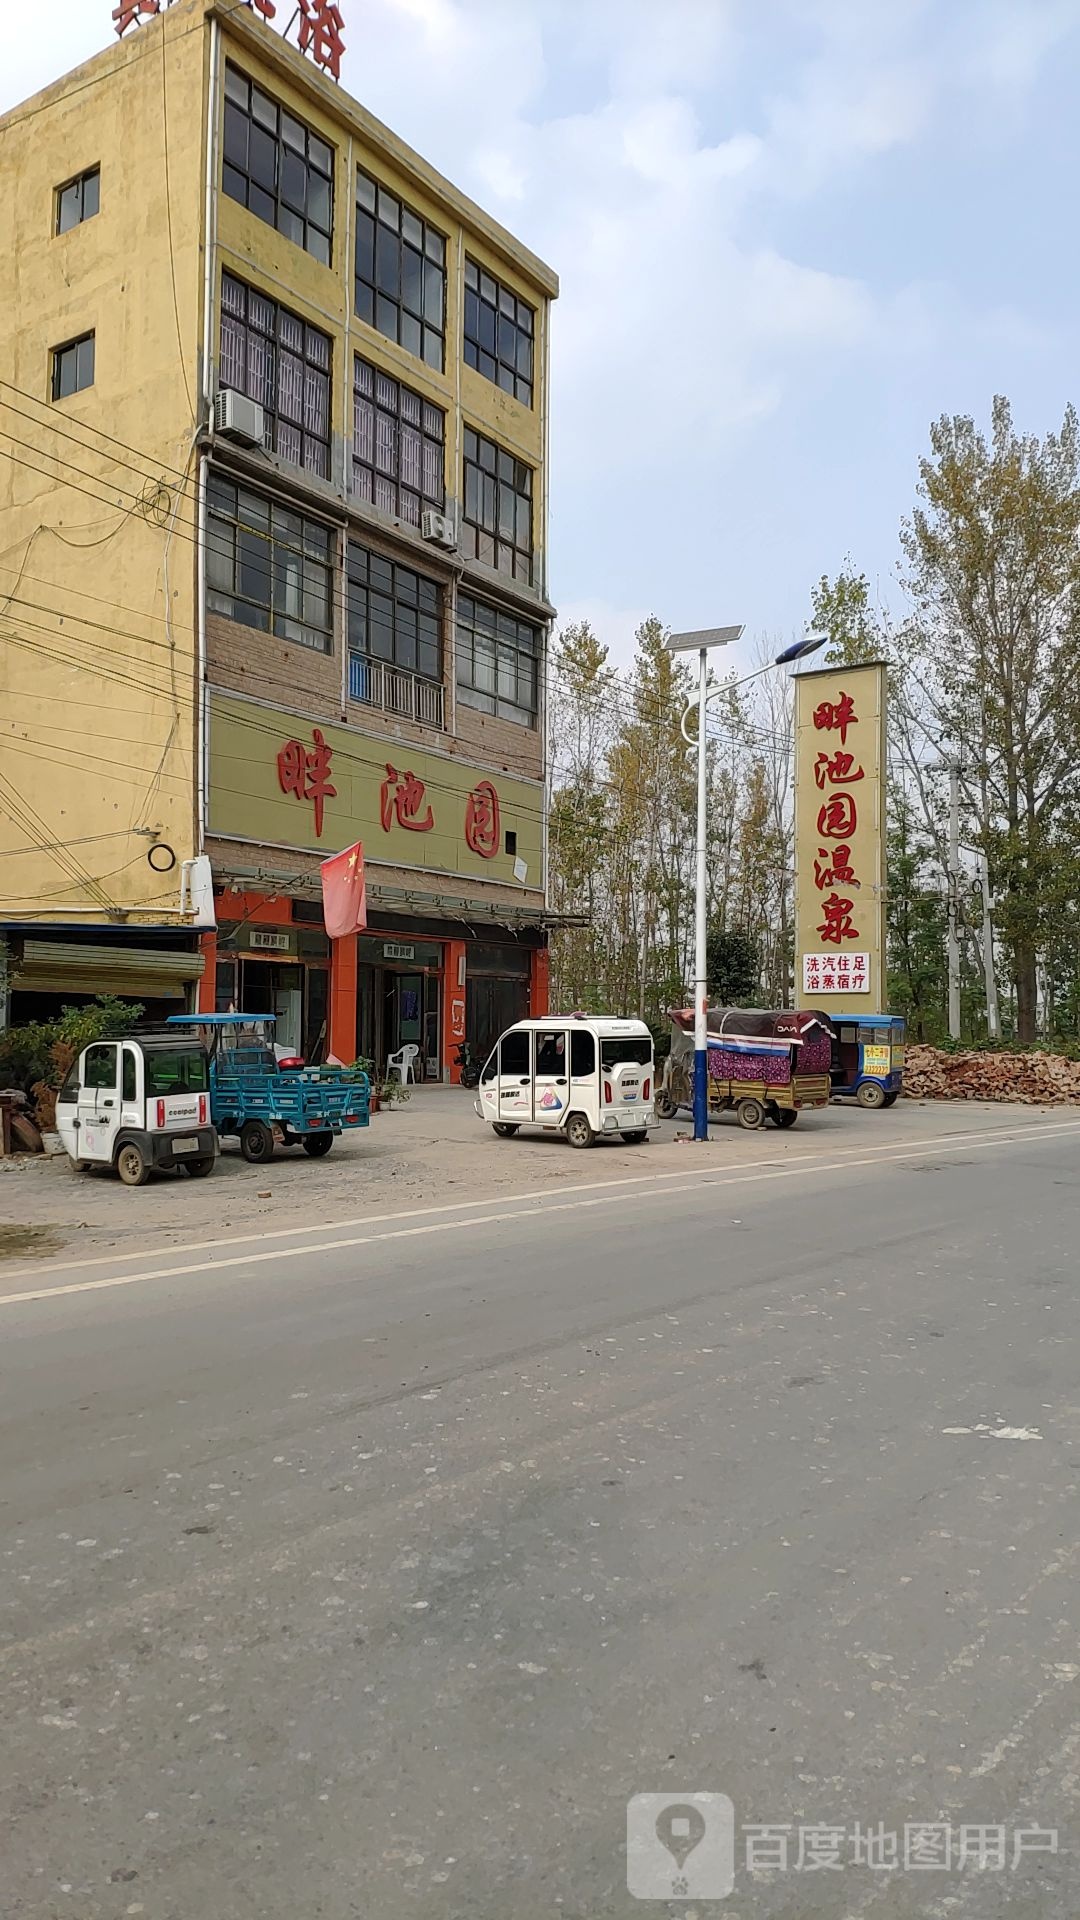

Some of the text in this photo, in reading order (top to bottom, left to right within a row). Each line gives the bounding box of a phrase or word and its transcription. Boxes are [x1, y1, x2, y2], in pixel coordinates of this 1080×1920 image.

[277, 728, 501, 859] 畔池园
[813, 691, 864, 945] 畔池园温泉
